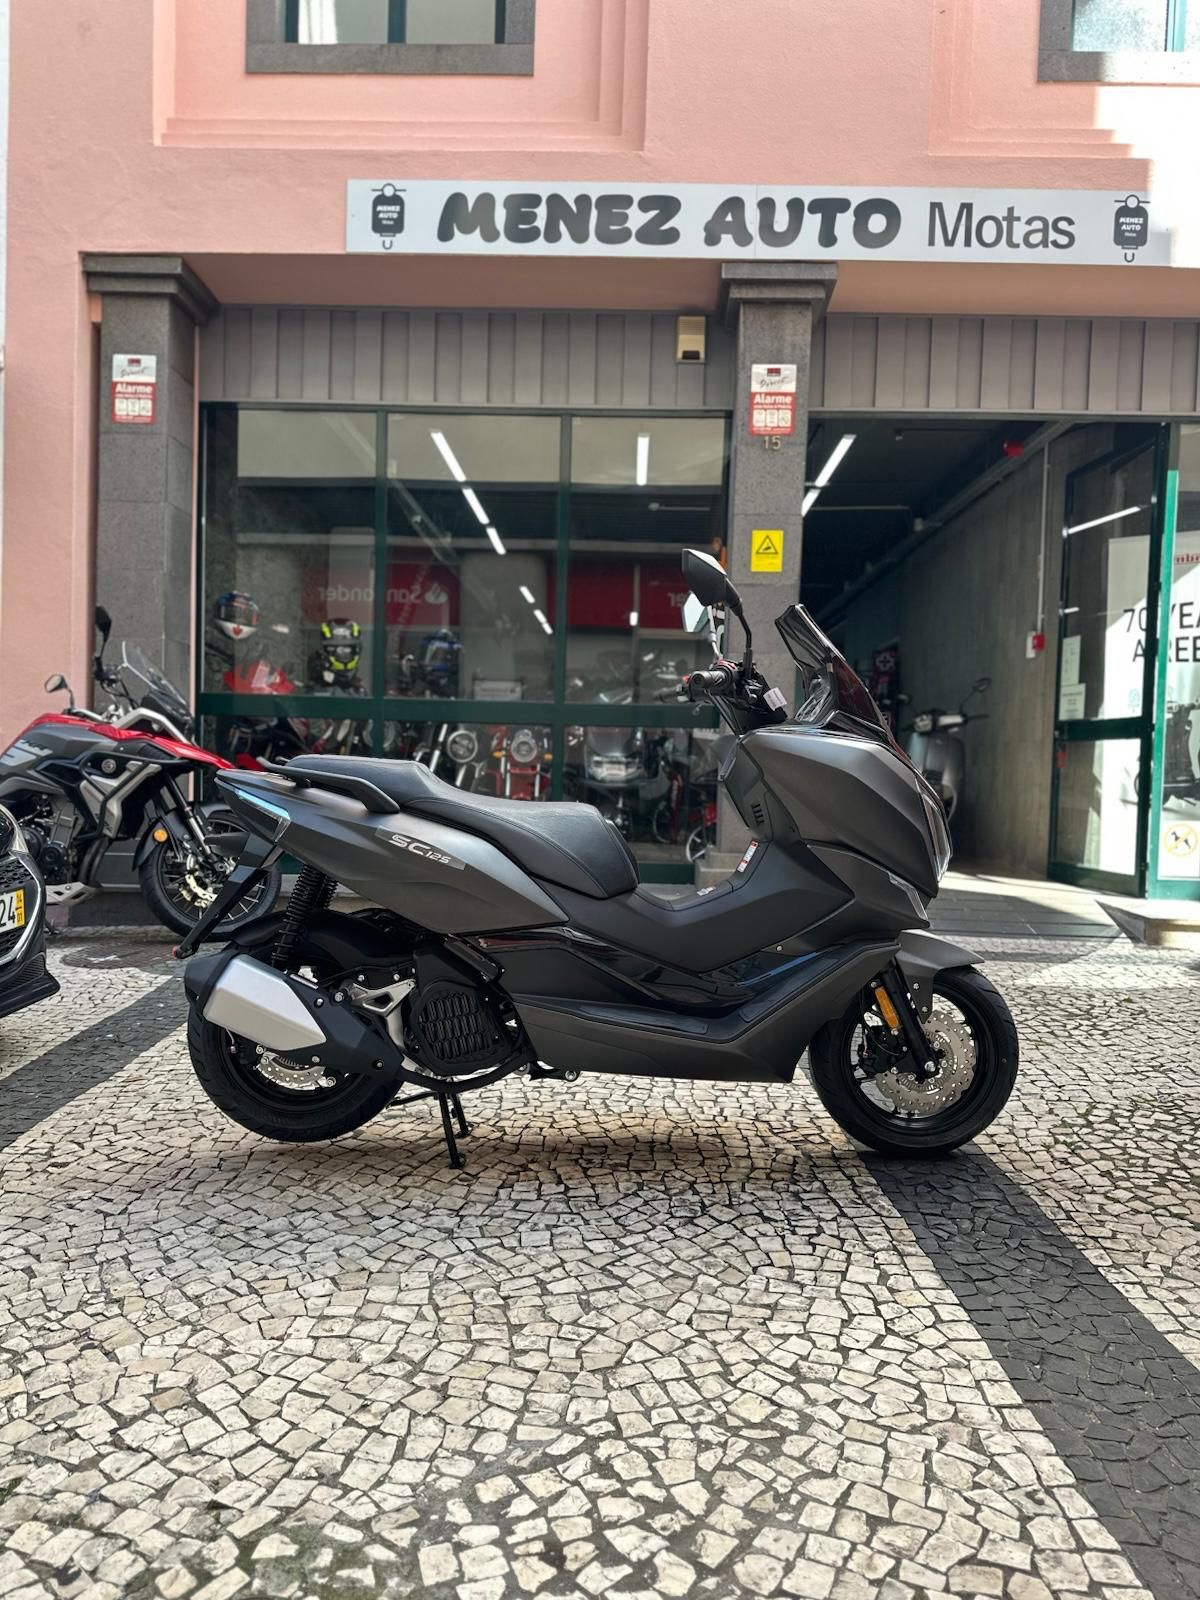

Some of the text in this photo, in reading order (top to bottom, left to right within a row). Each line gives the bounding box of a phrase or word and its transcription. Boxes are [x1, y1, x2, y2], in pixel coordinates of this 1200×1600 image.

[437, 192, 1076, 249] MENEZ AUTO Motas
[115, 382, 153, 394] Alarme
[753, 393, 793, 405] Alarme
[764, 435, 781, 450] 15
